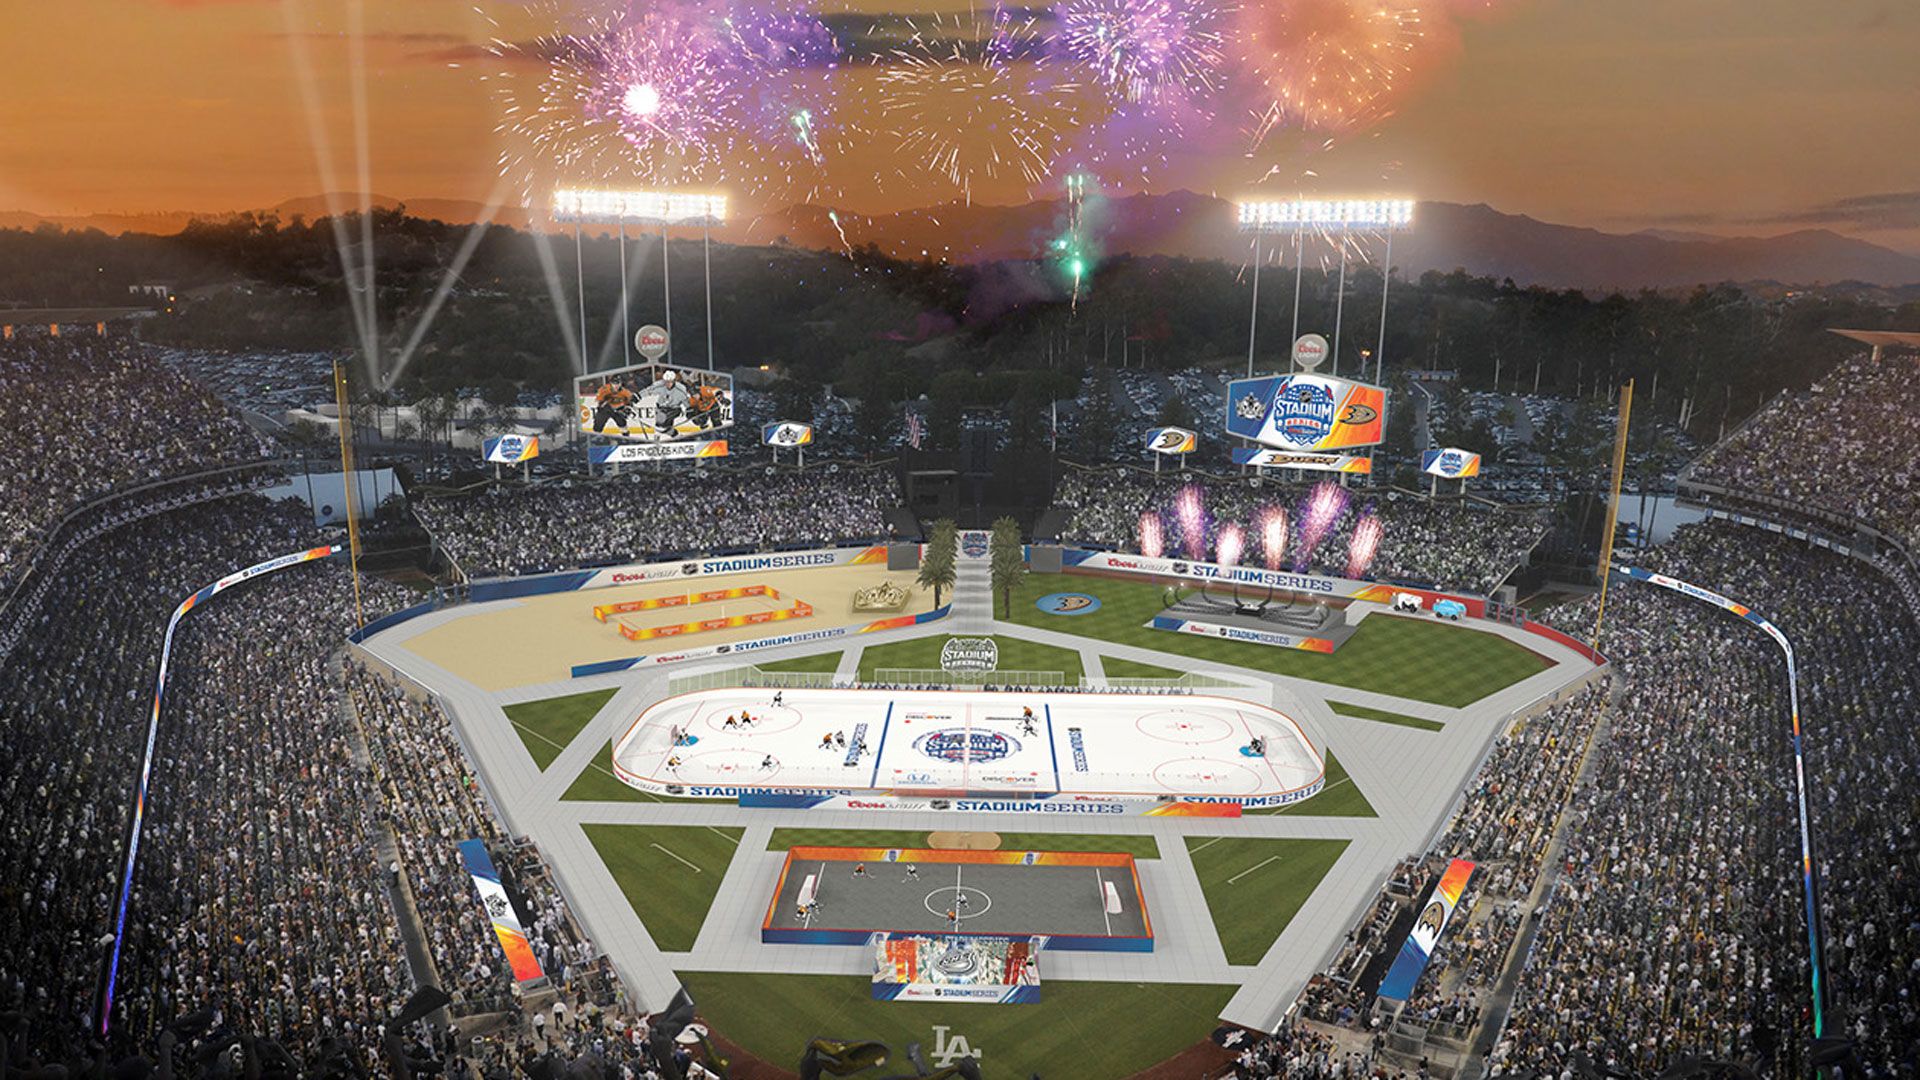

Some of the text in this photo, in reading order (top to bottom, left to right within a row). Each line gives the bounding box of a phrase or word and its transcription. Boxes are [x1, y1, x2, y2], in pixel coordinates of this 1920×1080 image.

[1276, 400, 1332, 422] STADIUM
[621, 447, 637, 458] LOS
[1108, 558, 1137, 569] Coors
[612, 573, 646, 582] Coors
[944, 650, 995, 662] STADIUM
[847, 800, 886, 809] Coors
[930, 1025, 982, 1069] LA
